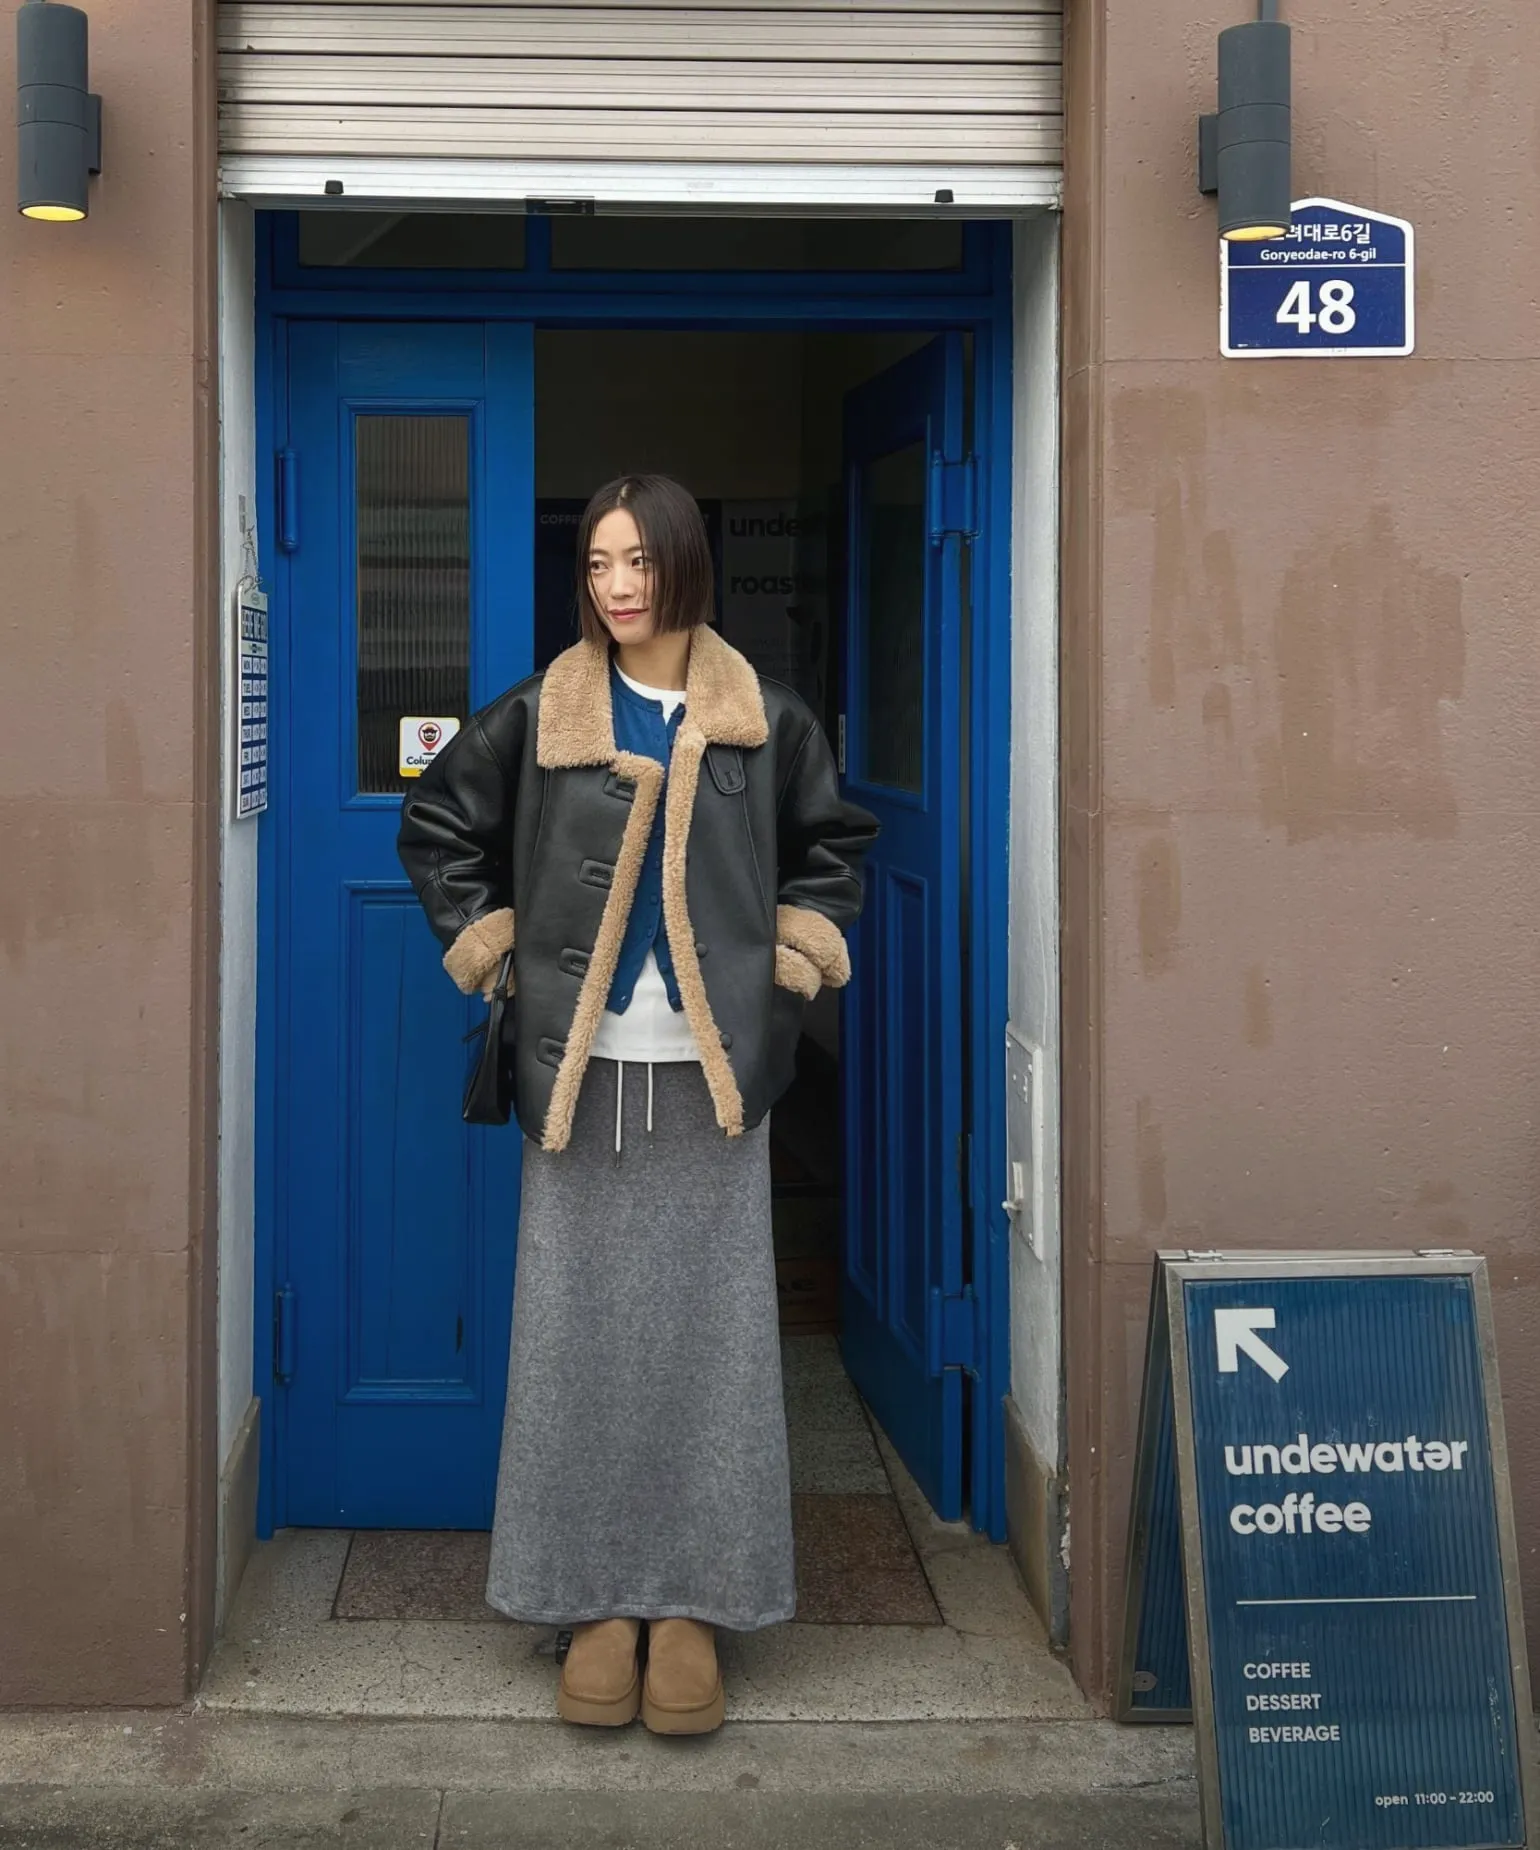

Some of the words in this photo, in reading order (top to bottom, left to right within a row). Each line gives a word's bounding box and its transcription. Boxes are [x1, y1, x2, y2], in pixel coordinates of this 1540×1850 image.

[1268, 223, 1371, 244] 려대로6길
[1260, 248, 1346, 263] Goryeodae-ro
[1348, 247, 1377, 262] 6-gil
[1276, 280, 1356, 334] 48
[730, 511, 803, 537] unde
[730, 575, 797, 596] roas
[406, 755, 432, 766] Colu
[1230, 1492, 1372, 1535] coffee
[1243, 1662, 1311, 1679] COFFEE
[1246, 1694, 1321, 1711] DESSERT
[1249, 1725, 1340, 1743] BEVERAGE
[1375, 1795, 1408, 1808] open
